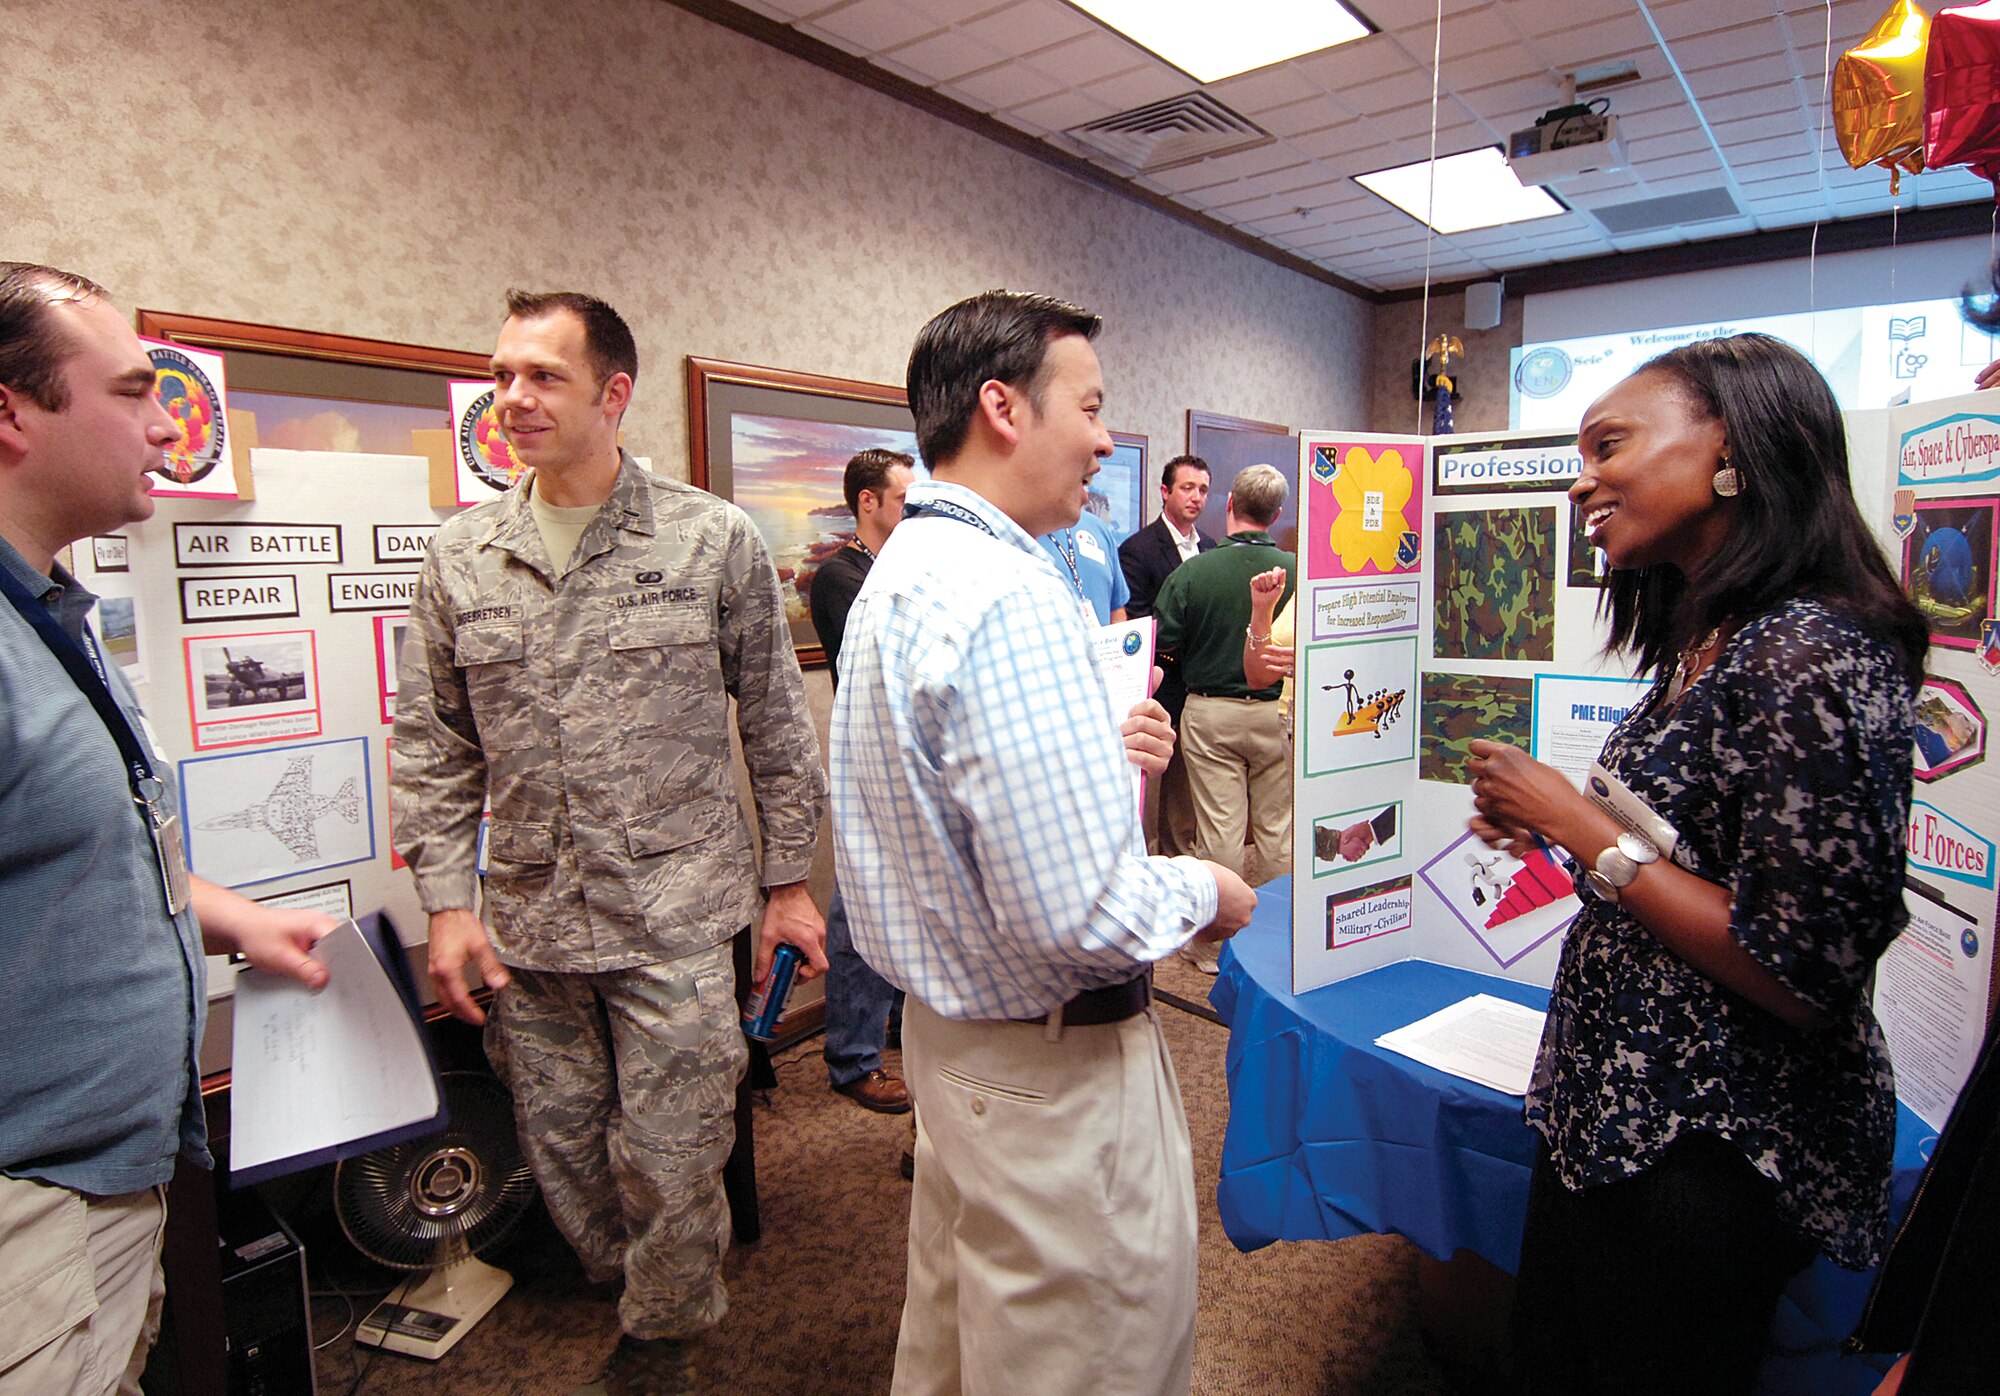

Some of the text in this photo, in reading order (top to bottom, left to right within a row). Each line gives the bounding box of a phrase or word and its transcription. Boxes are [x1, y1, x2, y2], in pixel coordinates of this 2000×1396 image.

[1629, 326, 1737, 346] Welcome to the
[150, 349, 224, 453] BATTLE DAMAGE REPAIR
[461, 395, 491, 467] USAF AIRCRAFT
[1902, 446, 1916, 471] Air,
[1918, 439, 1943, 477] Space
[1945, 429, 1953, 463] &
[1366, 496, 1380, 504] BDE
[1365, 519, 1380, 528] PDE
[189, 535, 230, 553] AIR
[250, 536, 332, 553] BATTLE
[197, 586, 281, 607] REPAIR
[617, 588, 697, 609] U.S. AIR FORCE
[1317, 589, 1416, 613] Prepare High Potential Employees
[1327, 608, 1407, 629] for Increased Responsibility
[1571, 703, 1596, 721] PME
[1923, 814, 1984, 871] Forces
[1336, 899, 1409, 924] Shared Leadership
[1339, 913, 1408, 936] Military -Civilian
